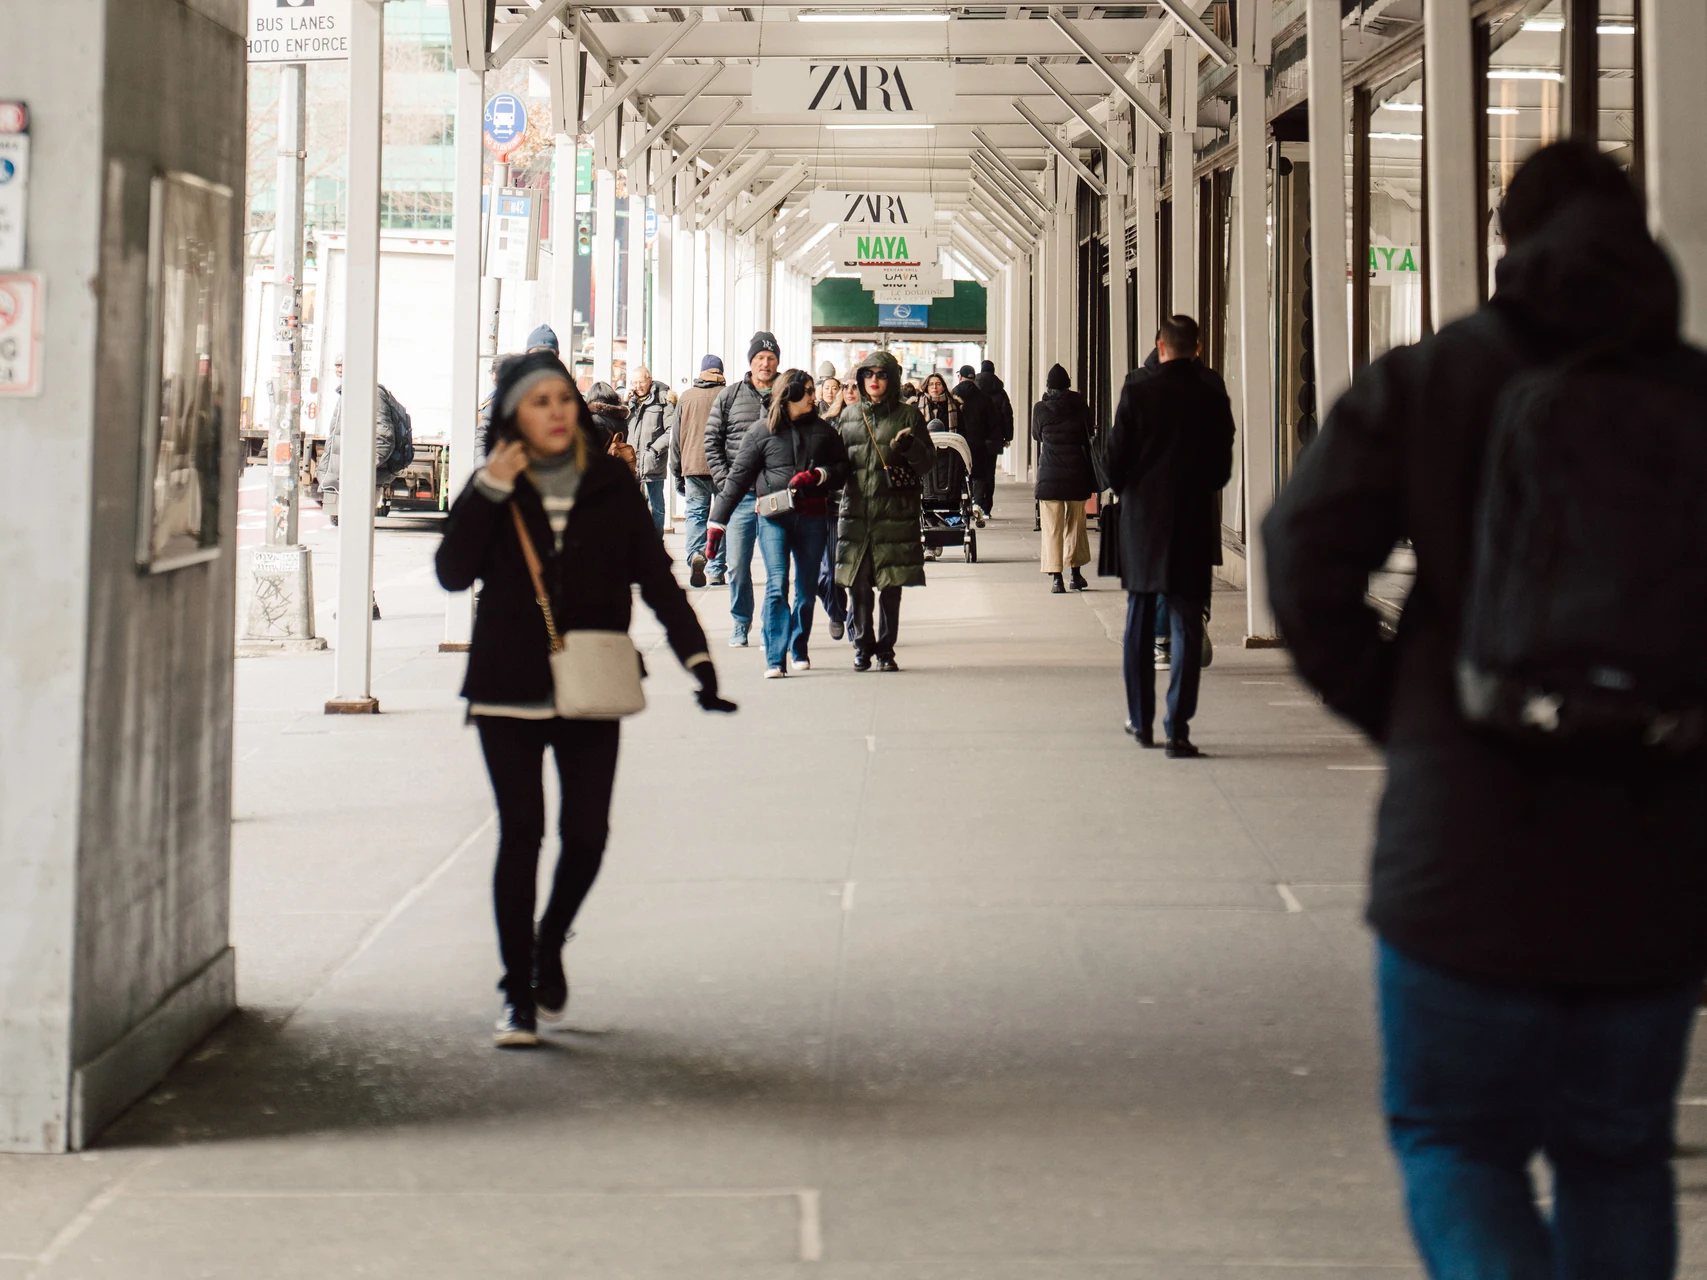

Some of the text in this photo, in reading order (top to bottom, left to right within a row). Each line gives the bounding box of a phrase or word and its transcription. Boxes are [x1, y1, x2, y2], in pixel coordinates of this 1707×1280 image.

[257, 16, 334, 31] BUS LANES
[286, 37, 347, 52] ENFORCE
[807, 64, 919, 112] ZARA
[485, 135, 521, 151] NO STANDING
[843, 194, 910, 224] ZARA
[857, 236, 909, 259] NAYA
